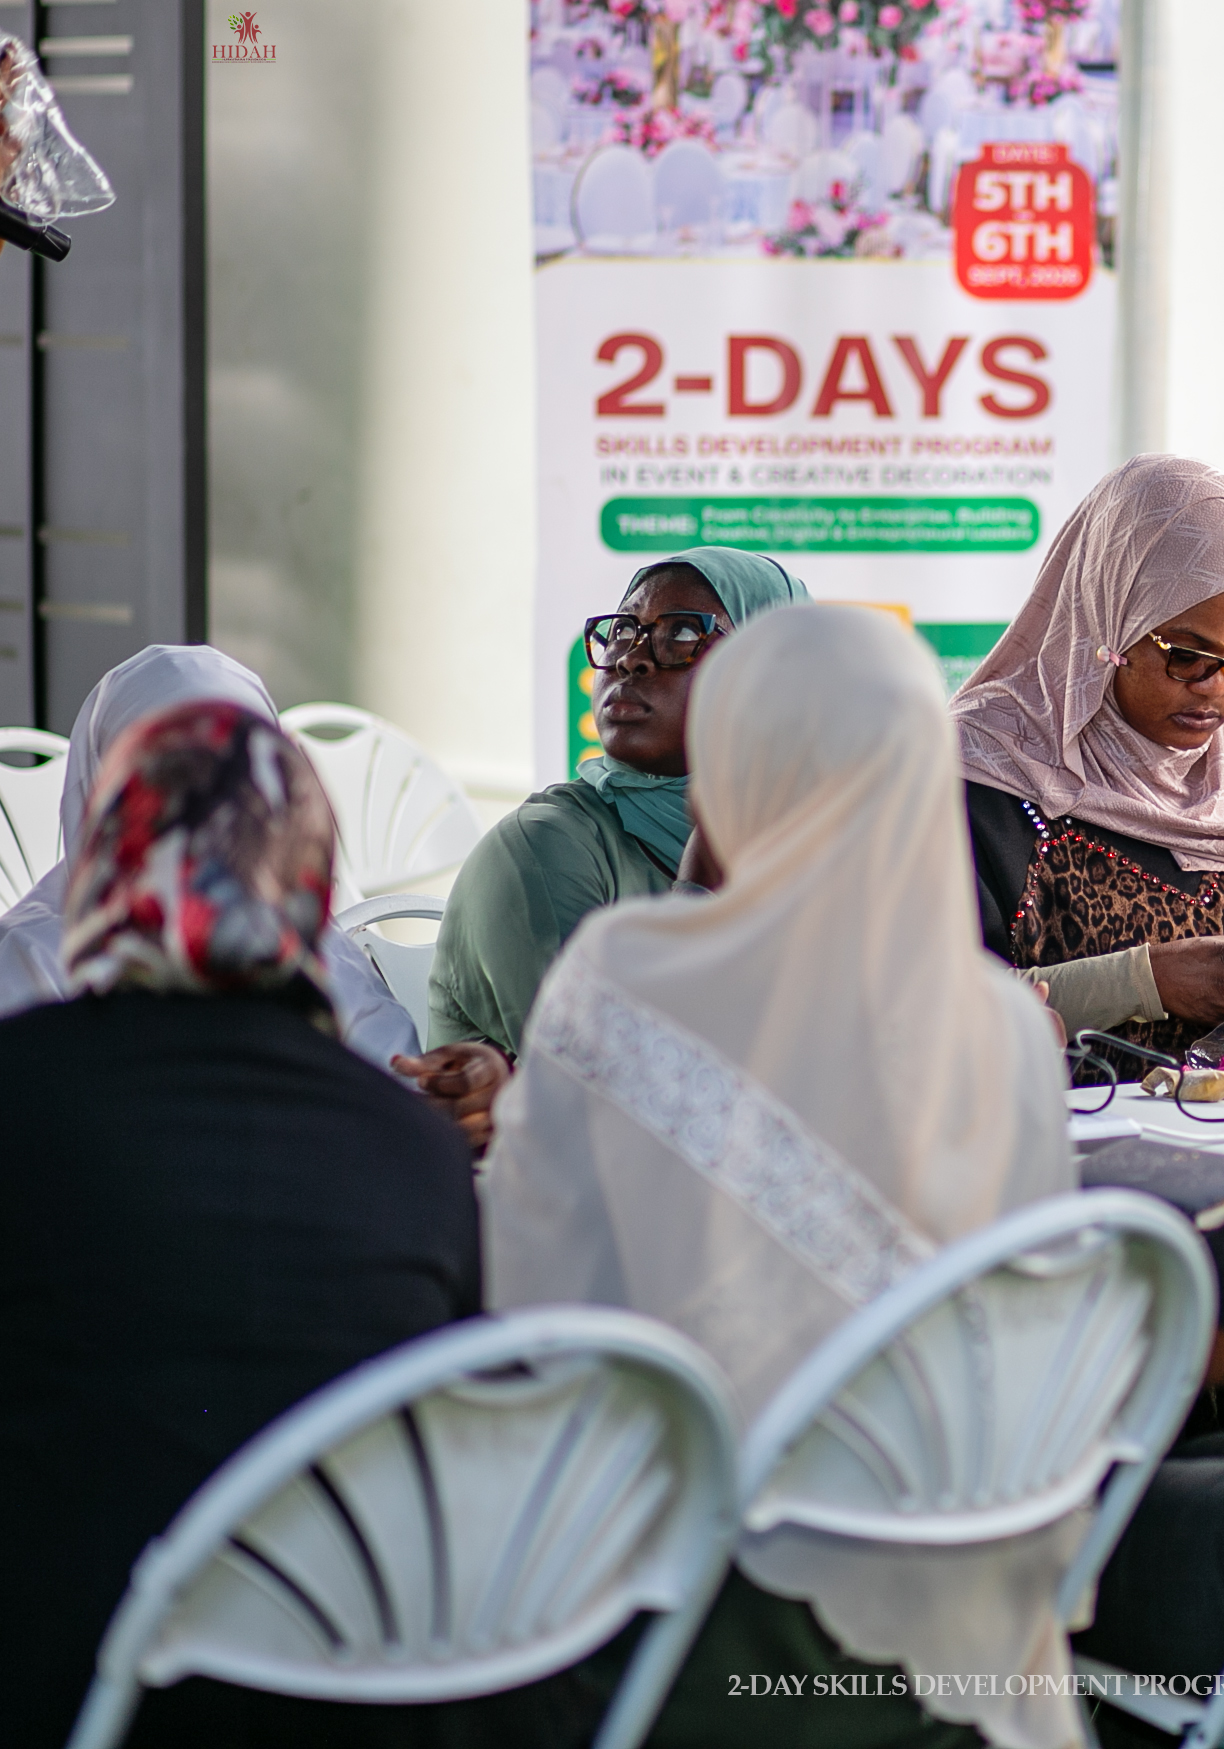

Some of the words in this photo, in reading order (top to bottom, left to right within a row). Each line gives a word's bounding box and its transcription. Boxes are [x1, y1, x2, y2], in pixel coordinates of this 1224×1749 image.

[973, 171, 1072, 212] 5TH
[972, 220, 1072, 262] 6TH
[595, 332, 1053, 420] 2-DAYS
[596, 434, 689, 458] SKILLS
[697, 434, 902, 458] DEVELOPMENT
[911, 434, 1053, 458] PROGRAM
[602, 465, 628, 486] IN
[637, 465, 720, 486] EVENT
[728, 465, 743, 486] &
[751, 465, 872, 486] CREATIVE
[882, 465, 1052, 486] DECORATION
